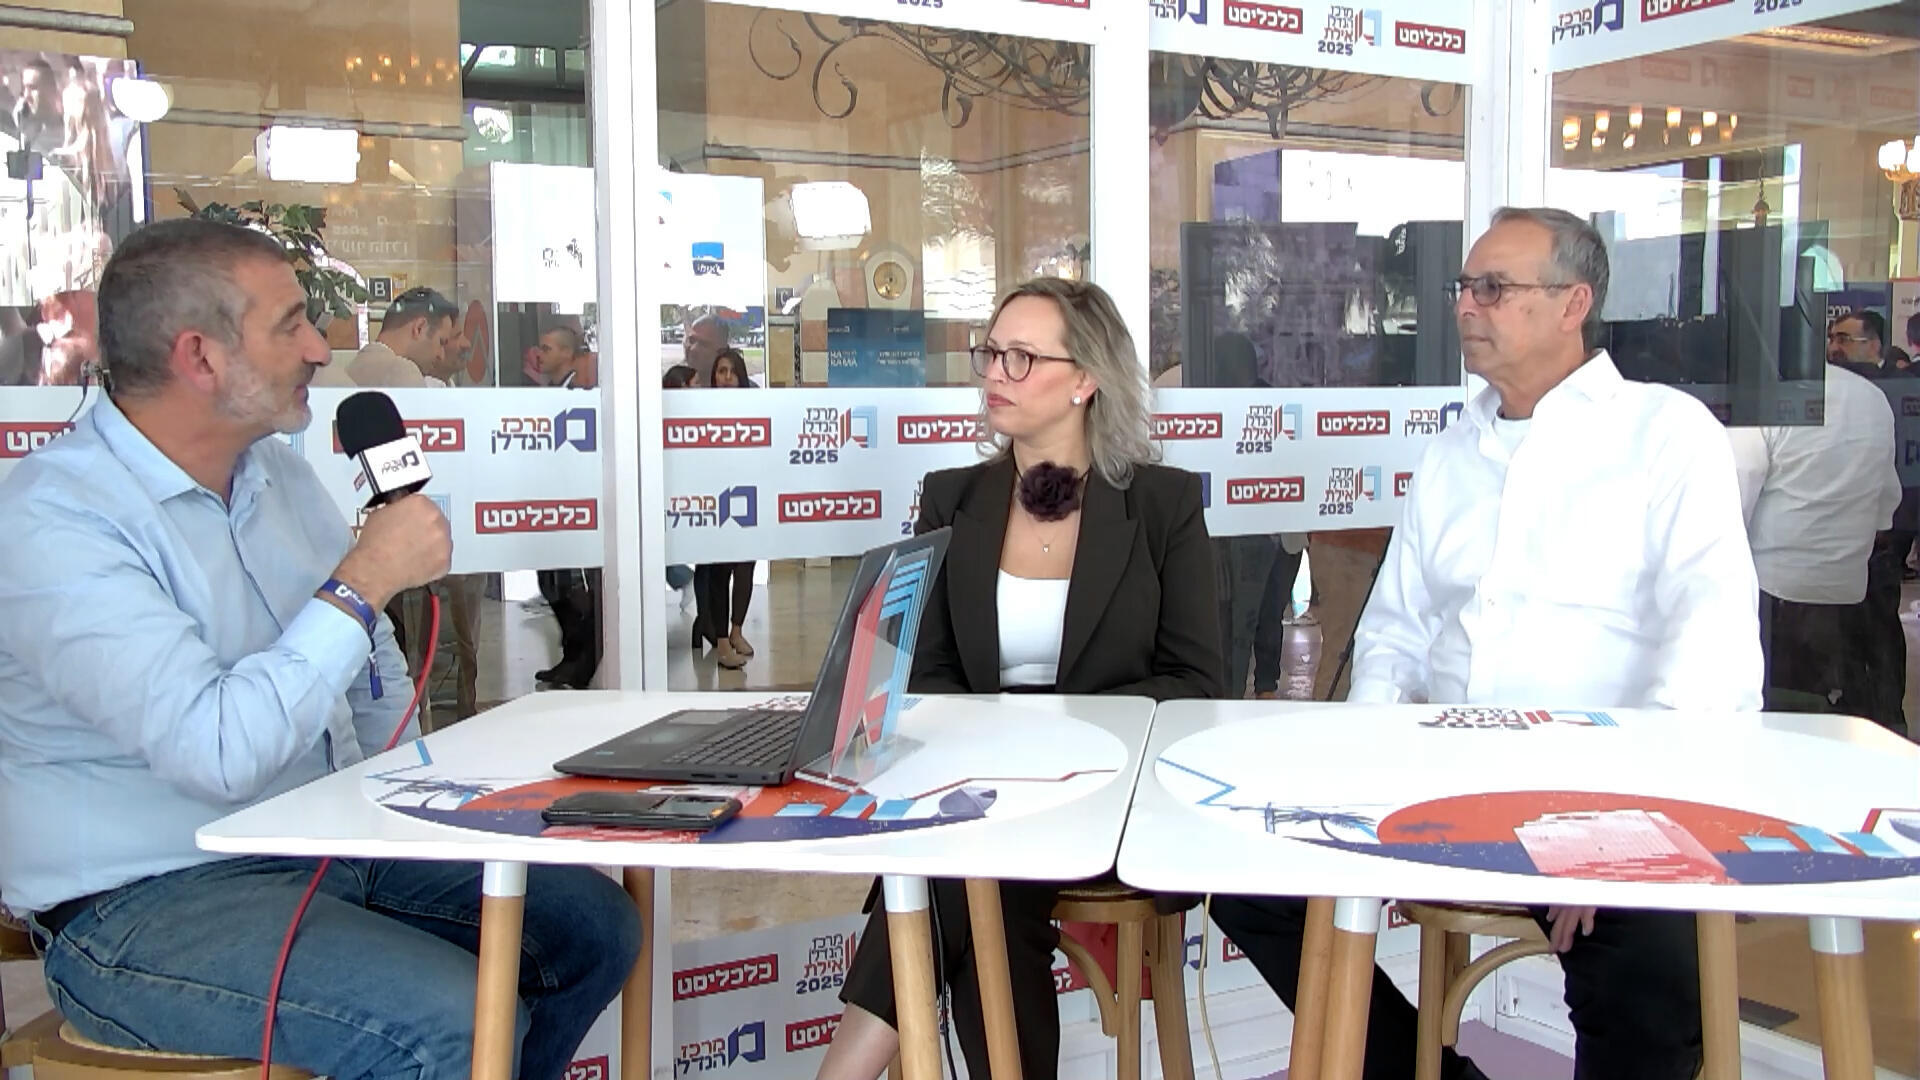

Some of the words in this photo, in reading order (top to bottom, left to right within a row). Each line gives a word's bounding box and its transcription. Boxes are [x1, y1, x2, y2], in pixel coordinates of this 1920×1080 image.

[1228, 6, 1299, 29] כלכליסט
[1559, 8, 1592, 26] מרכז
[1324, 27, 1353, 42] אילת
[1399, 27, 1462, 49] כלכליסט
[1552, 21, 1592, 45] הנדלן
[1318, 40, 1353, 56] 2025
[374, 281, 386, 297] B
[806, 407, 838, 421] מרכז
[1321, 414, 1386, 432] כלכליסט
[1409, 409, 1439, 421] מרכז
[501, 417, 551, 432] מרכז
[668, 422, 765, 443] כלכליסט
[803, 418, 838, 434] הנדלן
[1151, 417, 1218, 435] כלכליס
[1404, 419, 1439, 438] הנדלן
[491, 430, 552, 454] הנדלן
[797, 433, 839, 448] אילת
[1242, 427, 1272, 441] אילת
[789, 449, 839, 465] 2025
[1235, 441, 1273, 455] 2025
[1231, 482, 1300, 500] כלכליסט
[1325, 488, 1354, 503] אילת
[671, 495, 717, 511] מרכז
[784, 496, 876, 518] כלכליסט
[1319, 502, 1354, 516] 2025
[483, 504, 591, 528] כלכליסט
[812, 933, 844, 950] מרכז
[809, 945, 844, 966] הנדלן
[804, 959, 844, 978] אילת
[677, 960, 772, 996] כלכליסט
[796, 972, 844, 995] 2025
[681, 1037, 726, 1059] מרכז
